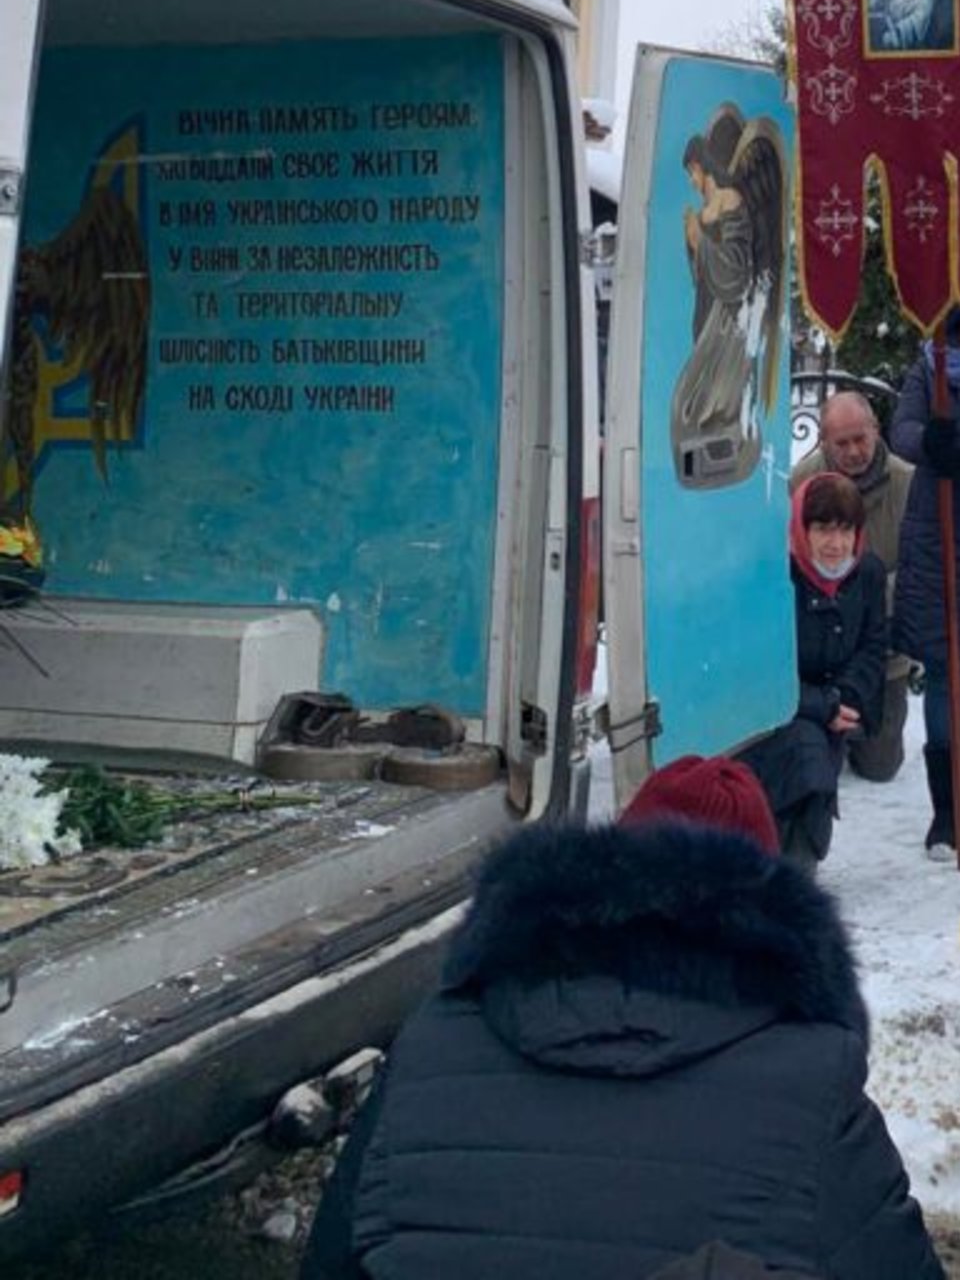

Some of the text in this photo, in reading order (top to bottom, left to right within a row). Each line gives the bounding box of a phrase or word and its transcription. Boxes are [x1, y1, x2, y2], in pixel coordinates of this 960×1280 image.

[351, 148, 439, 177] ЖИТТЯ
[389, 195, 481, 223] НАРОДУ
[168, 248, 183, 272] У
[194, 293, 219, 318] ТА
[271, 338, 426, 366] БАТЬКІВЩИНИ
[188, 386, 216, 411] НА
[225, 385, 294, 413] СХОДІ
